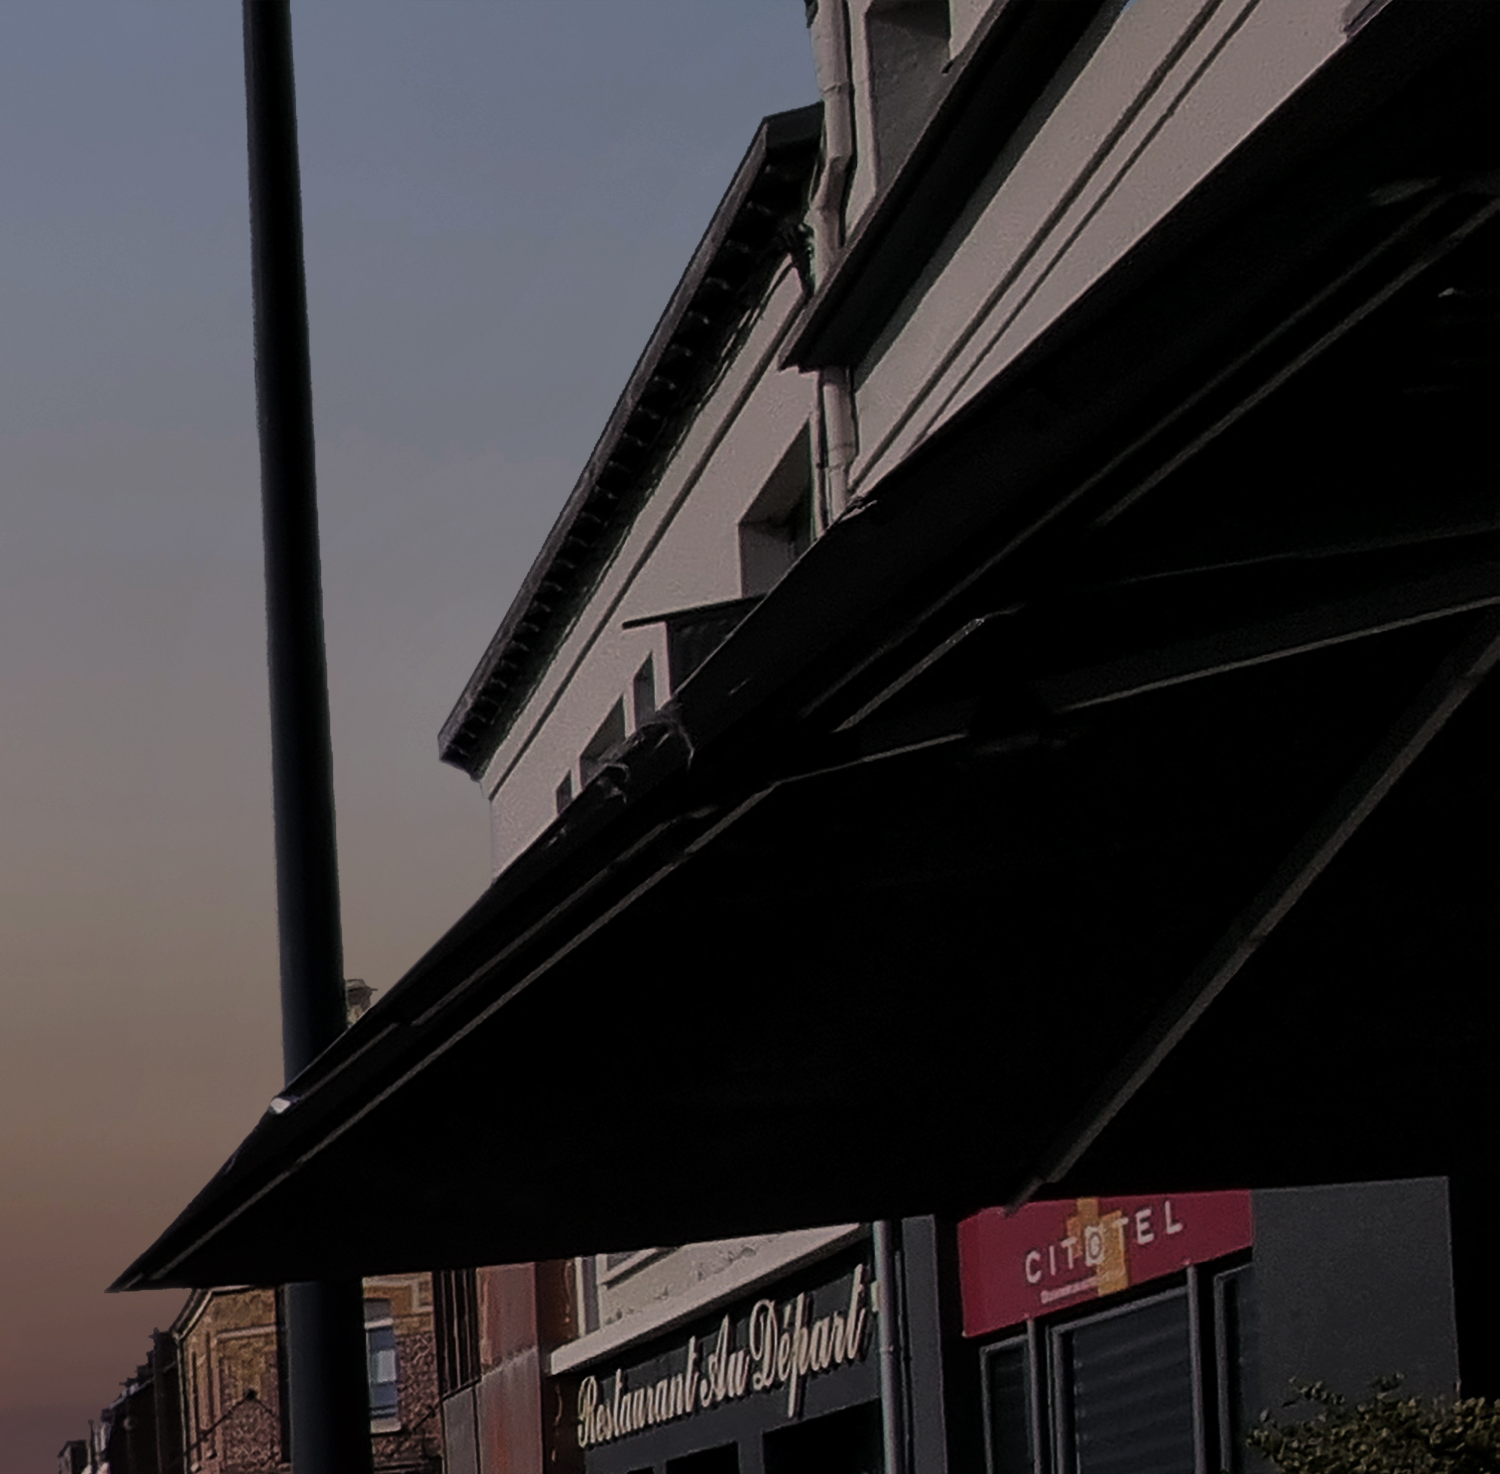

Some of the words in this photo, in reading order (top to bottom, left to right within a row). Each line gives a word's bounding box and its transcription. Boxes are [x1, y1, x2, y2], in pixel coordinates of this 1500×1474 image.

[1025, 1200, 1184, 1284] CITOTEL
[577, 1335, 698, 1447] Restaurant
[700, 1315, 751, 1406] Au
[750, 1264, 868, 1418] Départ
